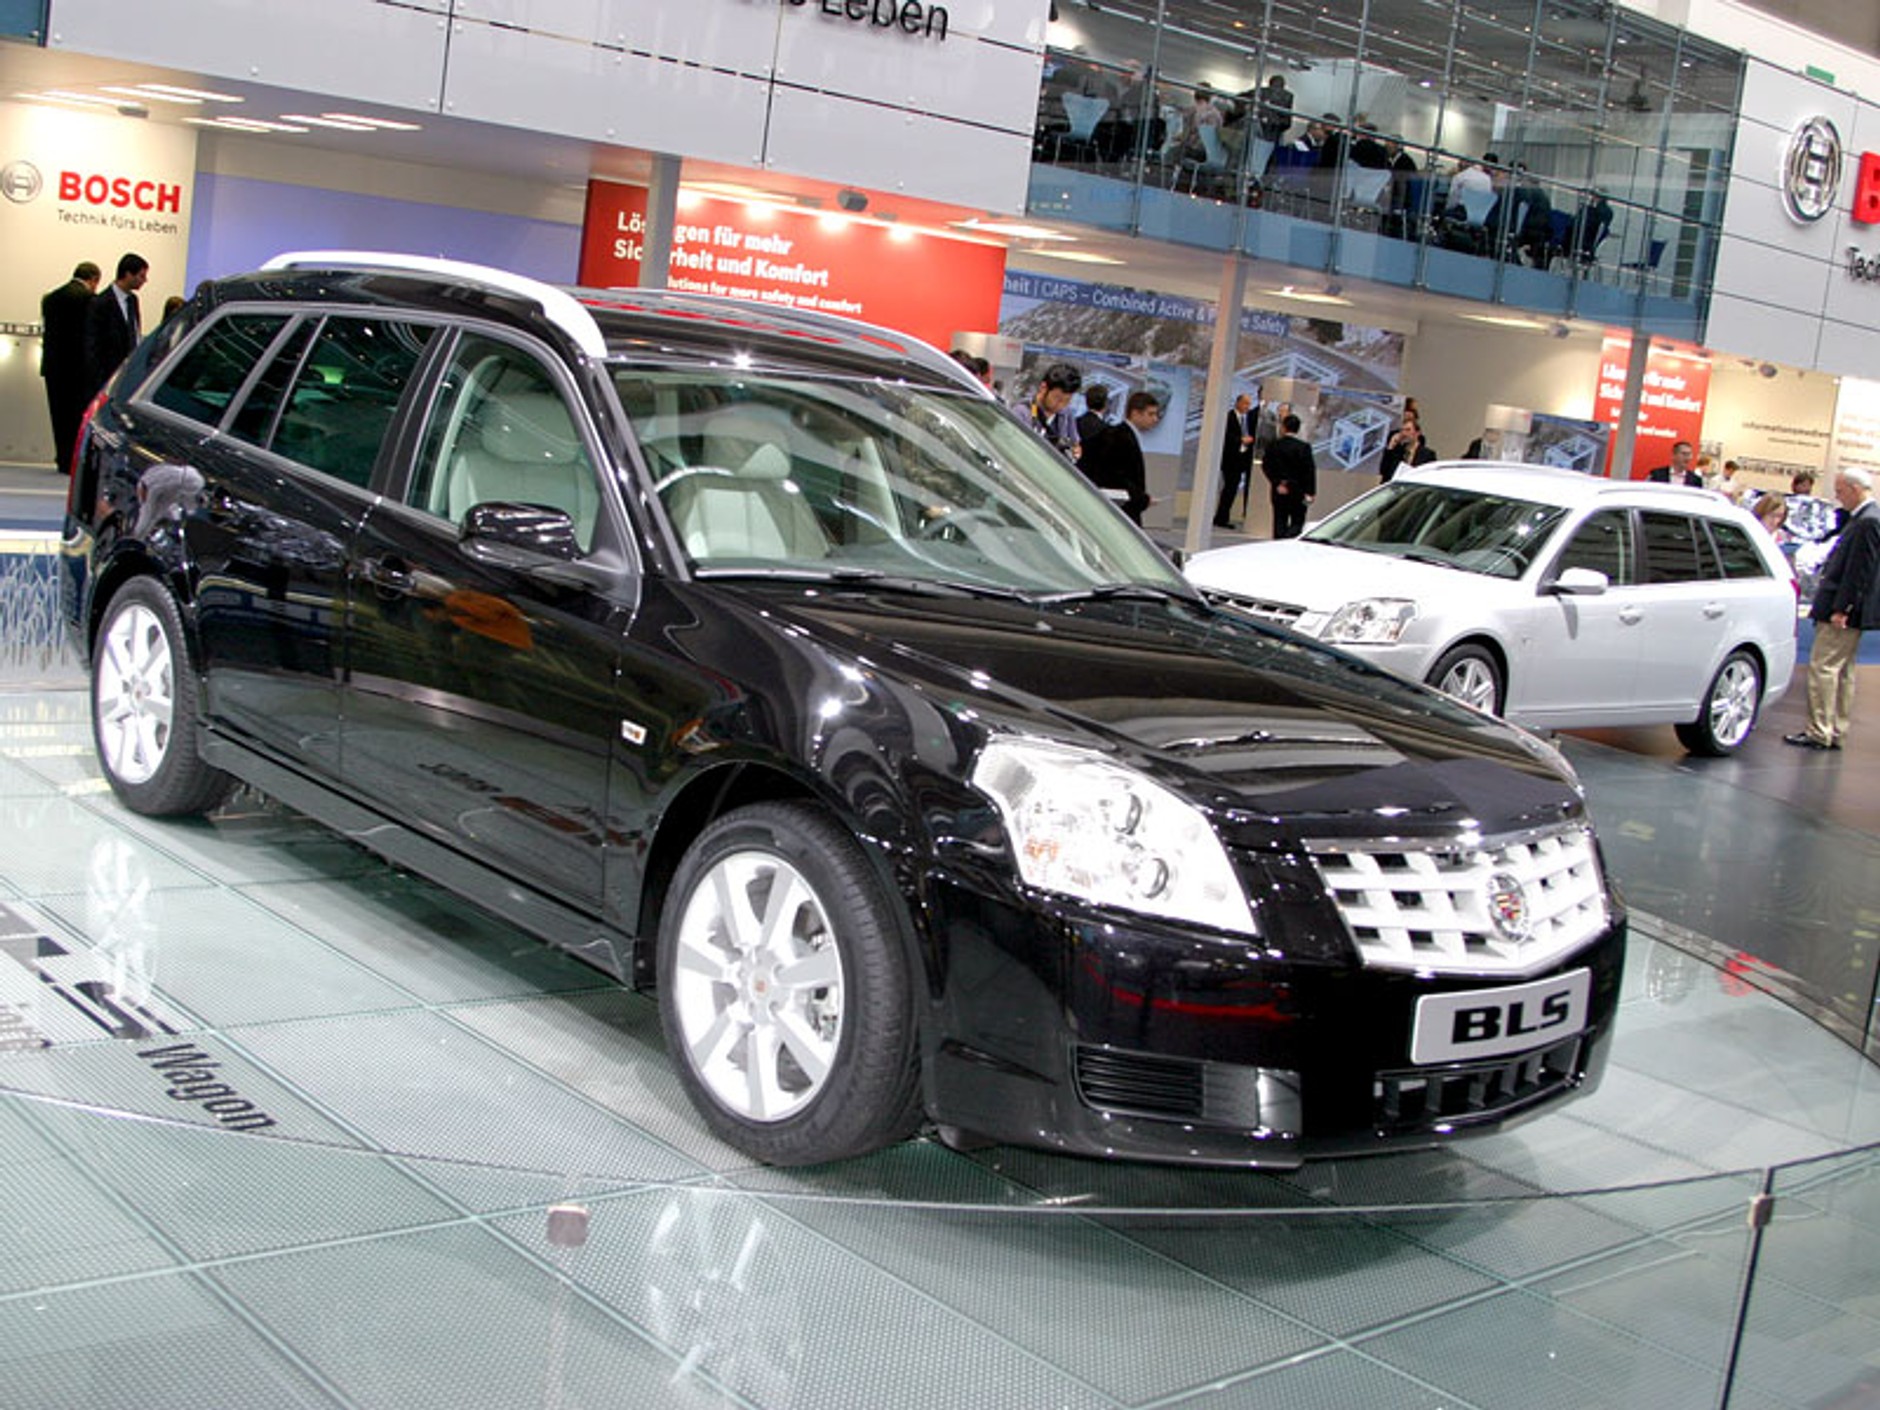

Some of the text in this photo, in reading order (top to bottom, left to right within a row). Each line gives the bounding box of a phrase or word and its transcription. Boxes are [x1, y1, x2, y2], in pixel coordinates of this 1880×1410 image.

[58, 171, 181, 213] BOSCH
[58, 209, 177, 234] Technik fürs Leben
[713, 226, 742, 248] für
[744, 233, 794, 255] mehr
[716, 256, 753, 276] und
[754, 258, 829, 288] Komfort
[1041, 282, 1078, 301] CAPS
[1092, 288, 1155, 314] Combined
[1157, 301, 1195, 321] Active
[1251, 314, 1286, 336] Safety
[1452, 990, 1570, 1044] BLS
[136, 1043, 277, 1132] Wagon
